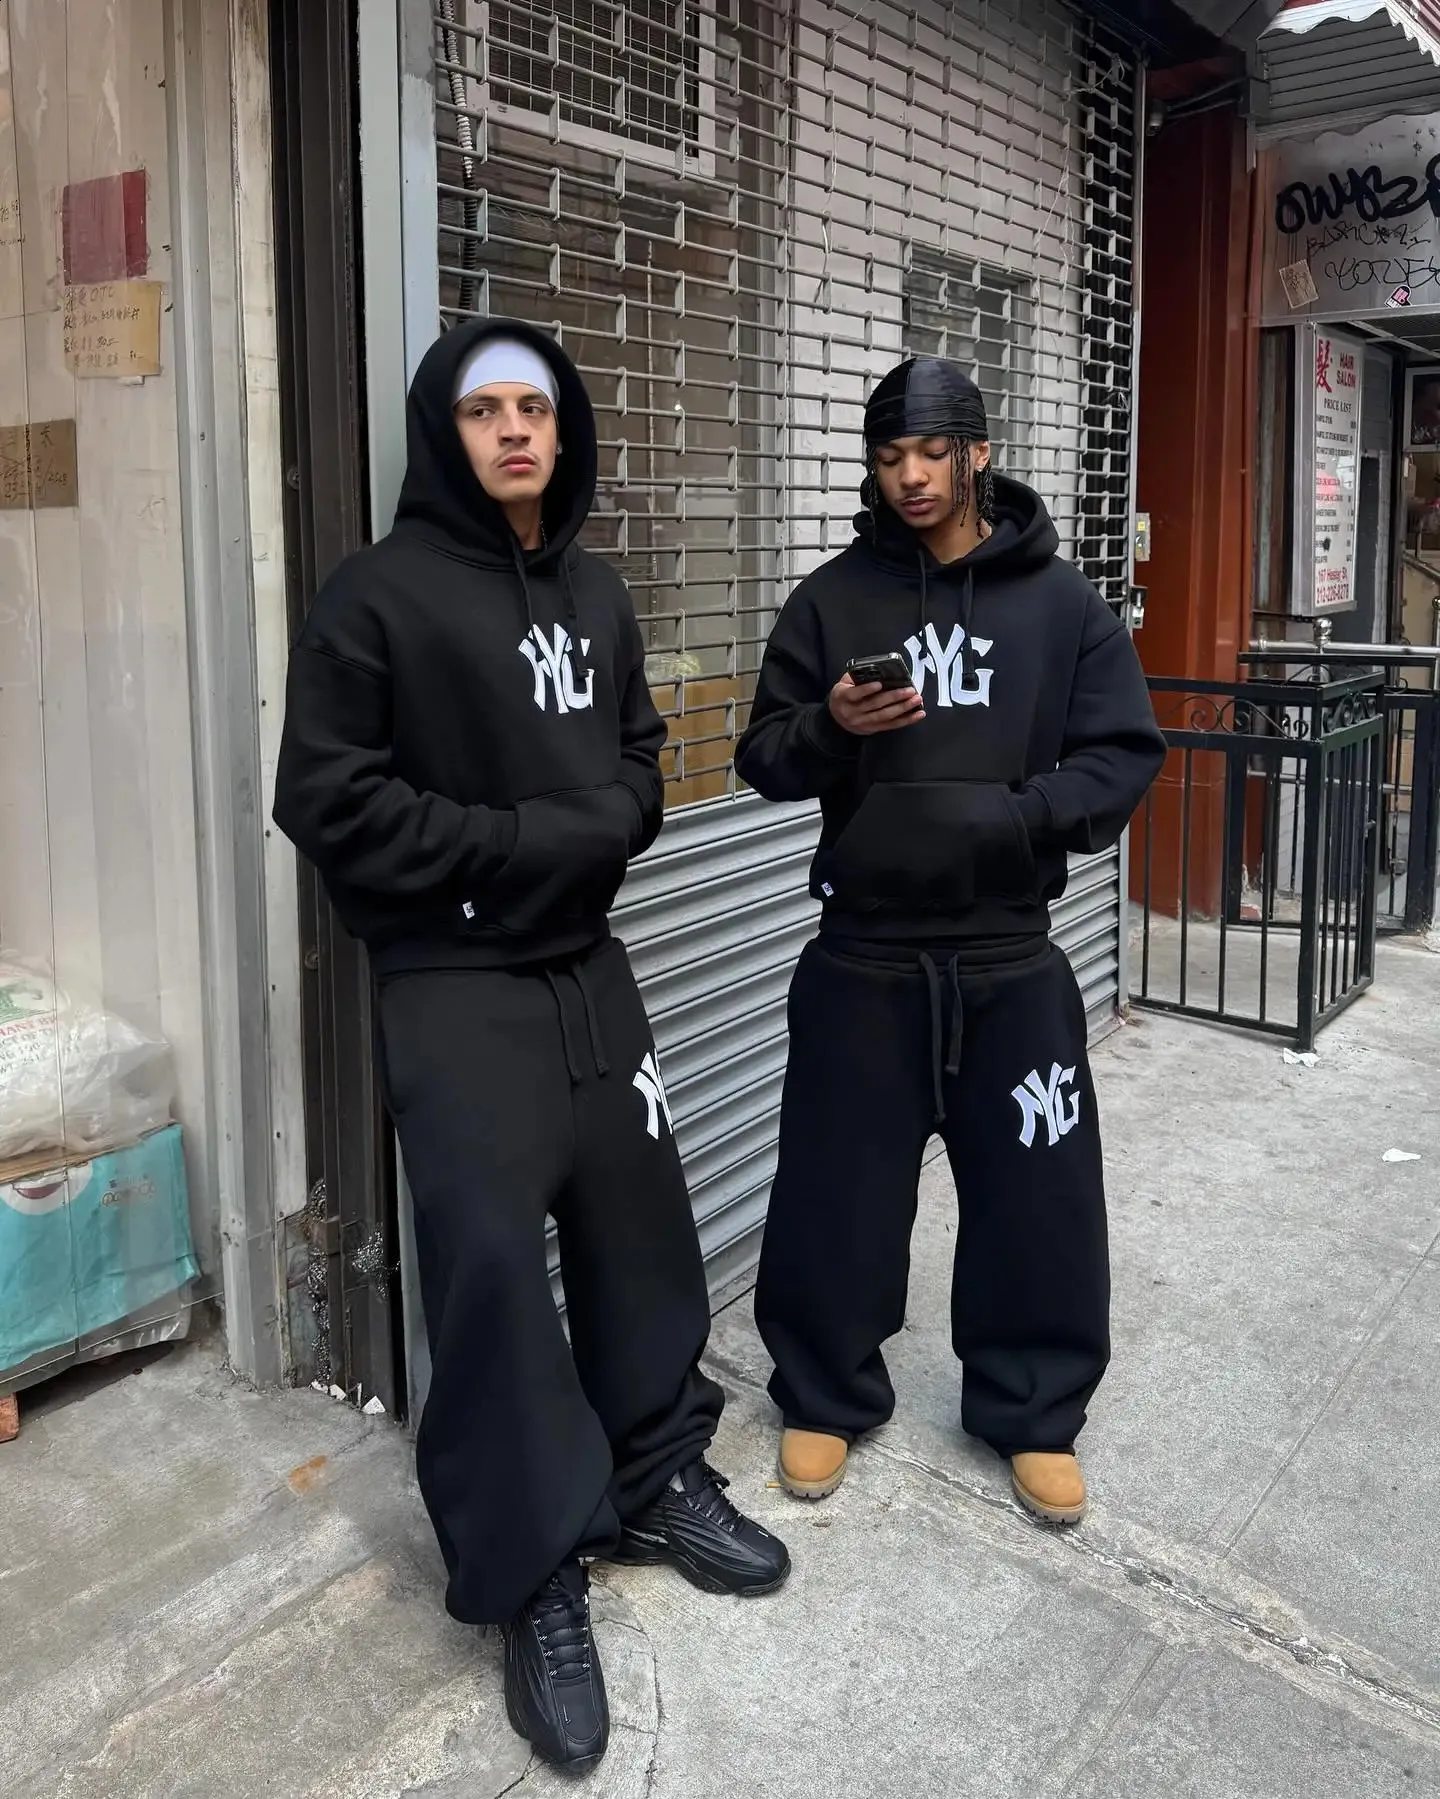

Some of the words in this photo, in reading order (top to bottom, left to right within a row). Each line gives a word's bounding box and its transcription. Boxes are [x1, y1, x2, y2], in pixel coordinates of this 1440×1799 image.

[1340, 352, 1354, 370] HAIR
[1336, 370, 1356, 389] SALON
[1324, 397, 1339, 412] PRICE
[1340, 400, 1352, 414] LIST
